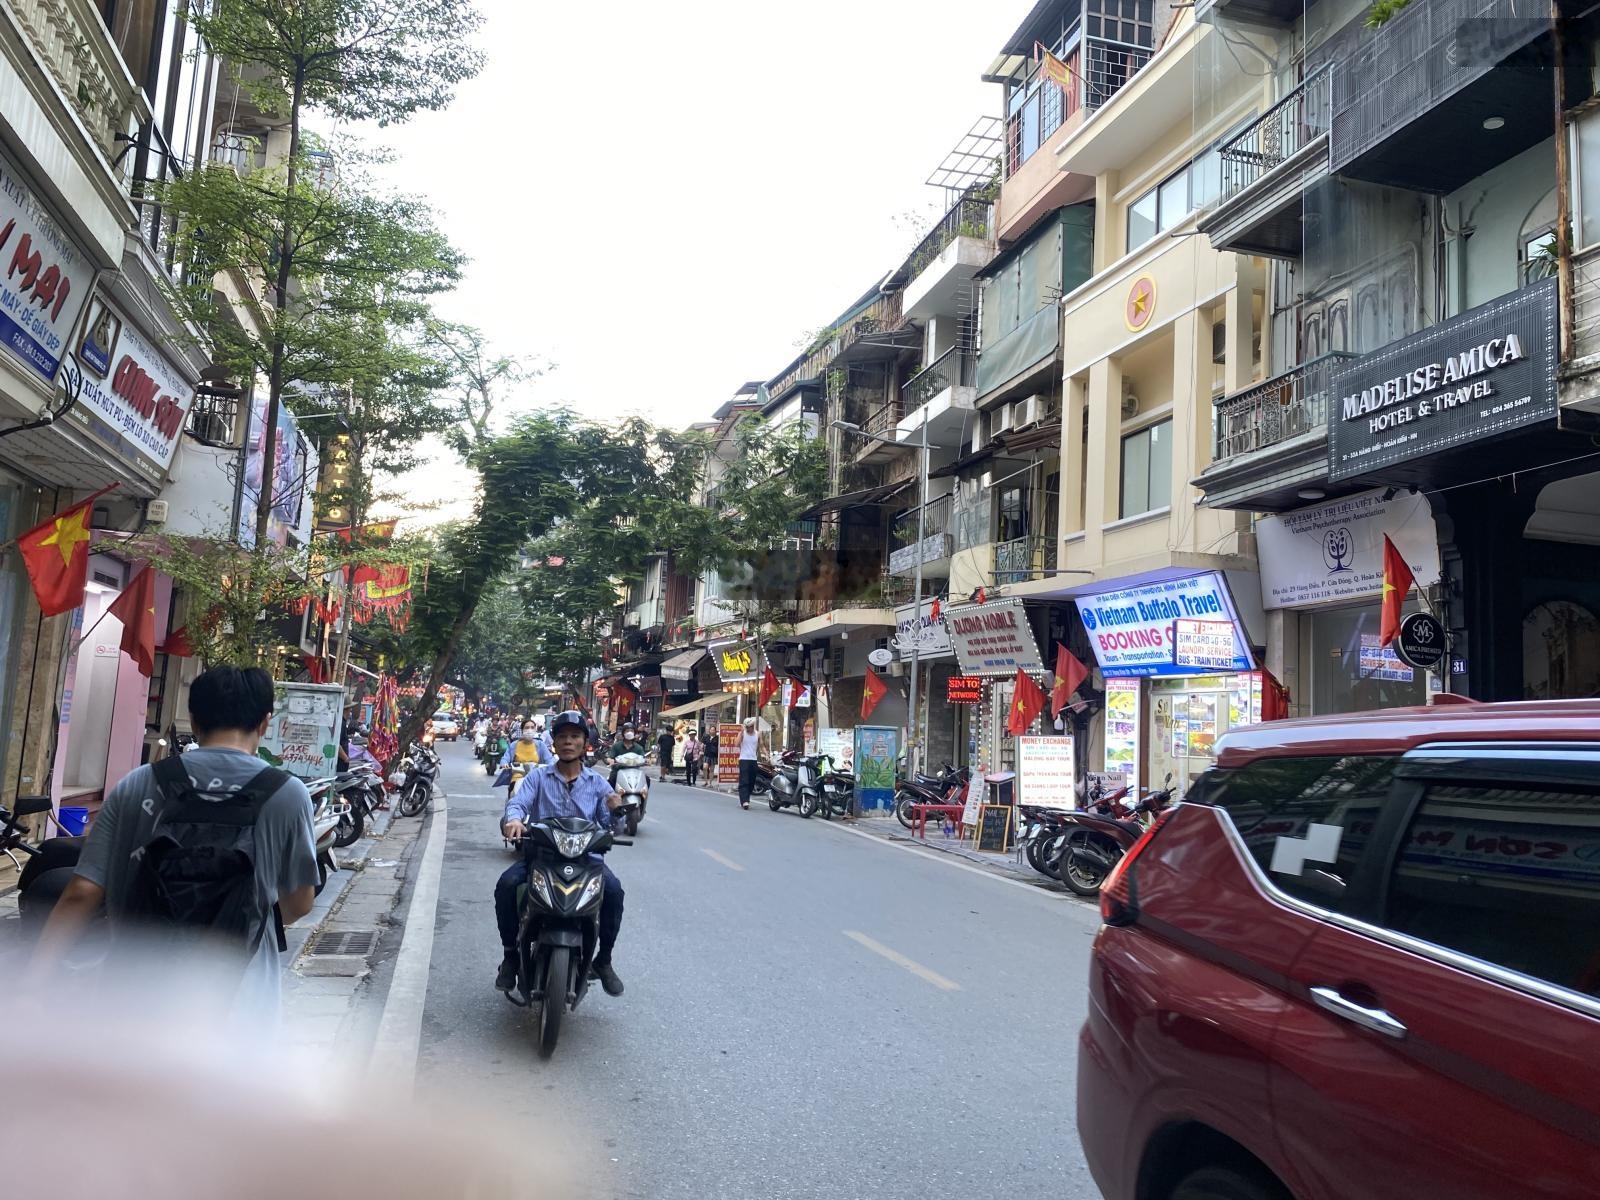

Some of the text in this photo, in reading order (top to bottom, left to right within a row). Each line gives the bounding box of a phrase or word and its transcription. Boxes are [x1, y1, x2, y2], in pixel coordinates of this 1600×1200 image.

[8, 232, 71, 324] MAI
[1342, 333, 1523, 422] MADELISE AMICA
[1369, 379, 1493, 434] HOTEL & TRAVEL
[1374, 495, 1389, 505] NA
[1352, 508, 1386, 520] Association
[1094, 589, 1222, 627] Vietnam Buffalo Travel
[982, 610, 1018, 630] MOBILE
[1098, 628, 1162, 651] BOOKING
[1178, 634, 1192, 644] SIM
[1104, 654, 1118, 662] Tours
[1122, 650, 1164, 661] Transportation
[1207, 646, 1232, 657] SERVICE
[1212, 657, 1232, 668] TICKET
[1453, 662, 1465, 672] 31
[950, 680, 978, 688] SIM TO
[1043, 737, 1072, 746] EXCHANGE
